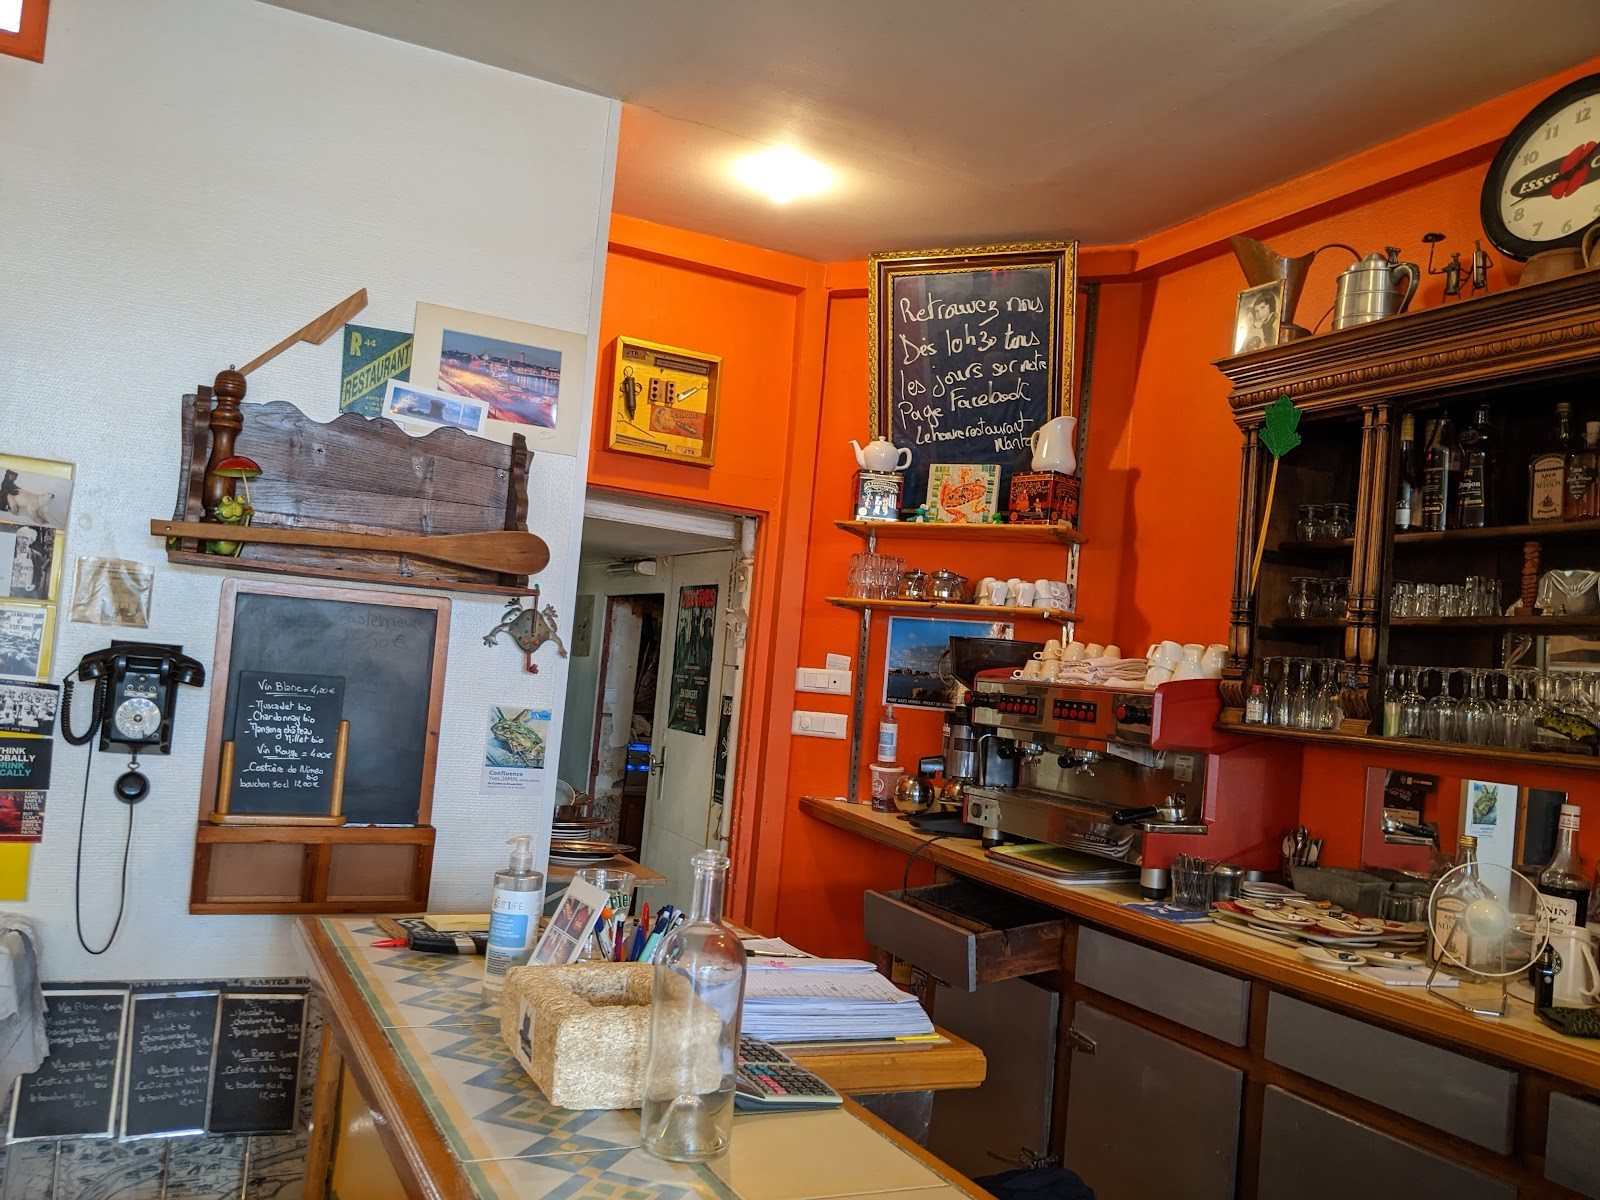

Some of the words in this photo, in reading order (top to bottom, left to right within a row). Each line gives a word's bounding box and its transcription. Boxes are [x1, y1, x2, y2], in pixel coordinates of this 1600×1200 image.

[1575, 107, 1592, 124] 12
[1545, 124, 1560, 141] 11
[1523, 150, 1540, 167] 10
[1513, 207, 1525, 222] 8
[1532, 221, 1544, 237] 7
[1561, 219, 1573, 234] 6
[350, 331, 362, 357] R
[342, 343, 413, 405] RESTAURANT
[900, 369, 927, 401] les
[932, 362, 984, 398] jours
[991, 360, 1019, 377] sur
[897, 400, 945, 431] Page
[950, 377, 1032, 413] Facebook
[257, 679, 272, 690] Vin
[275, 681, 303, 692] Blanc
[298, 702, 312, 711] bio
[253, 711, 301, 727] Chardonnay
[302, 713, 316, 723] bio
[311, 735, 325, 743] bio
[0, 754, 37, 763] OBALLY
[257, 743, 270, 754] Vin
[274, 745, 298, 759] Rouge
[0, 762, 26, 770] RINK
[0, 769, 32, 777] CALLY
[287, 765, 297, 773] de
